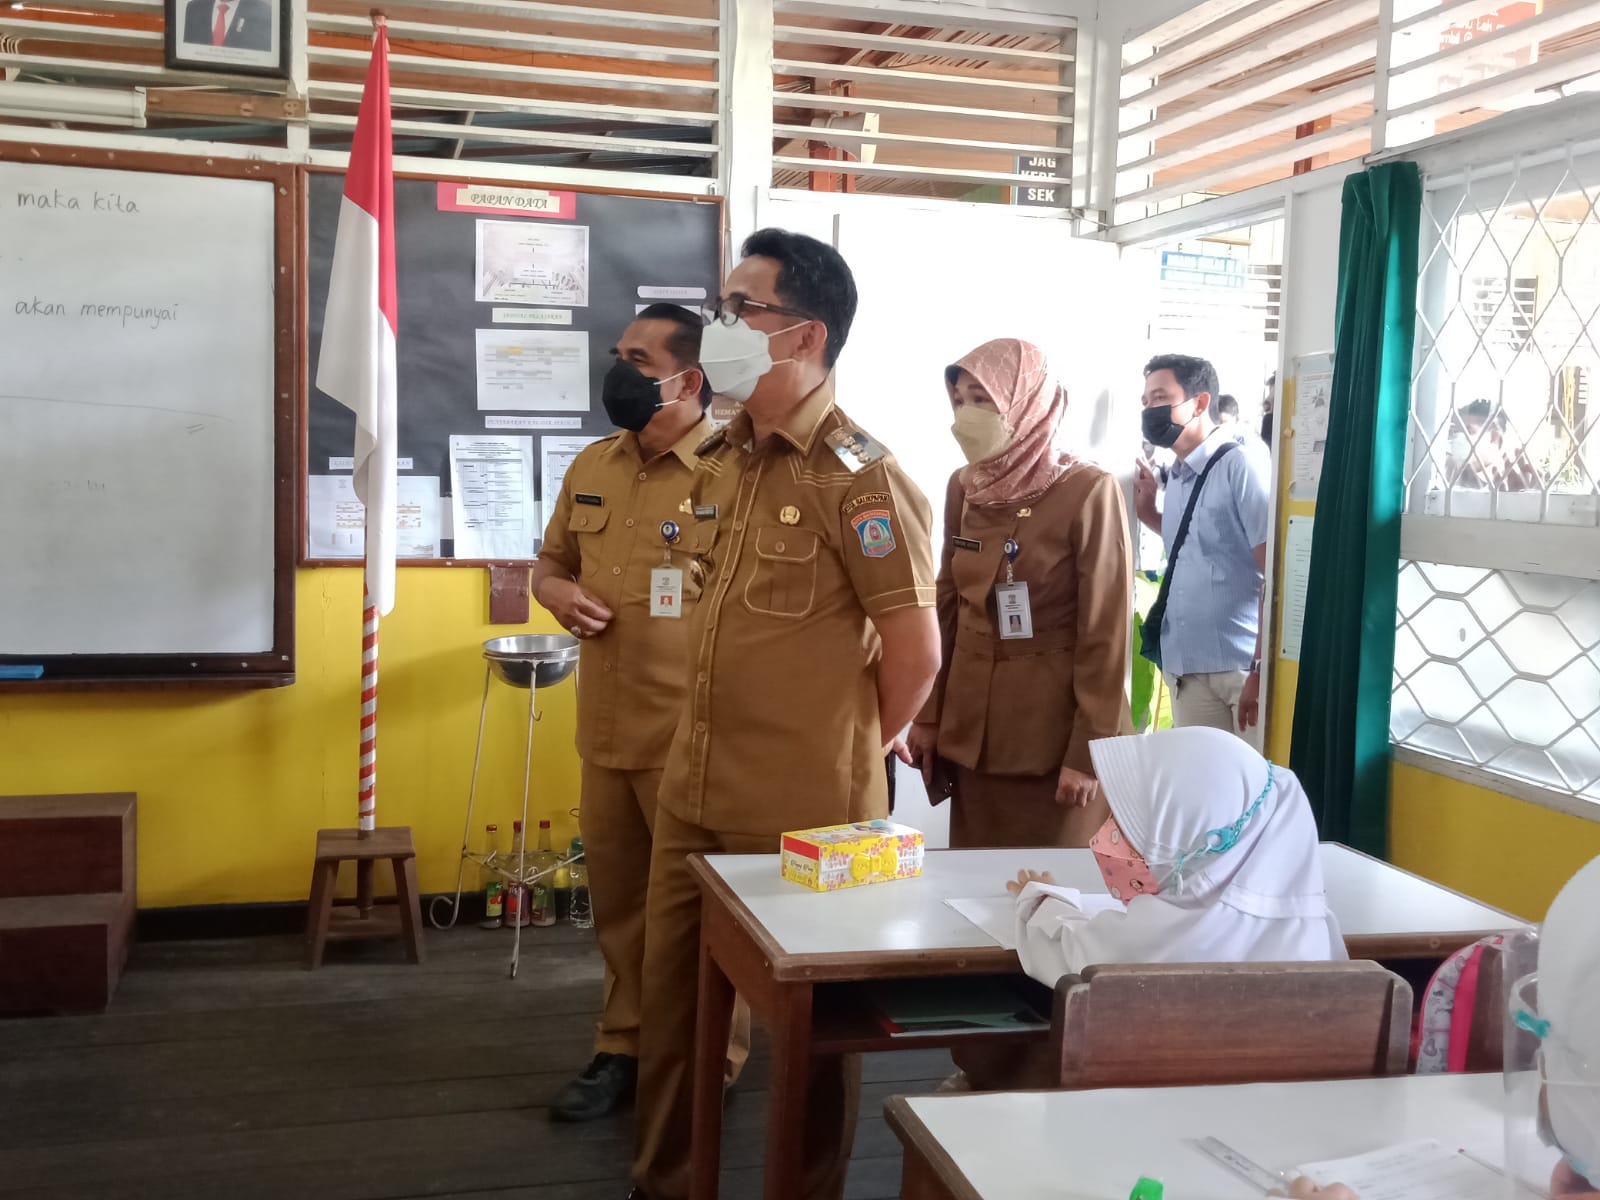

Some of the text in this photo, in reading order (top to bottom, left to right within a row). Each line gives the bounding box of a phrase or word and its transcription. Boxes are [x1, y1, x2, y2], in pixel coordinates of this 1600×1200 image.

[17, 188, 139, 214] maka kita
[470, 193, 548, 209] PAPAN DATA
[1027, 187, 1055, 202] SEK
[15, 295, 179, 329] akan mempunyai
